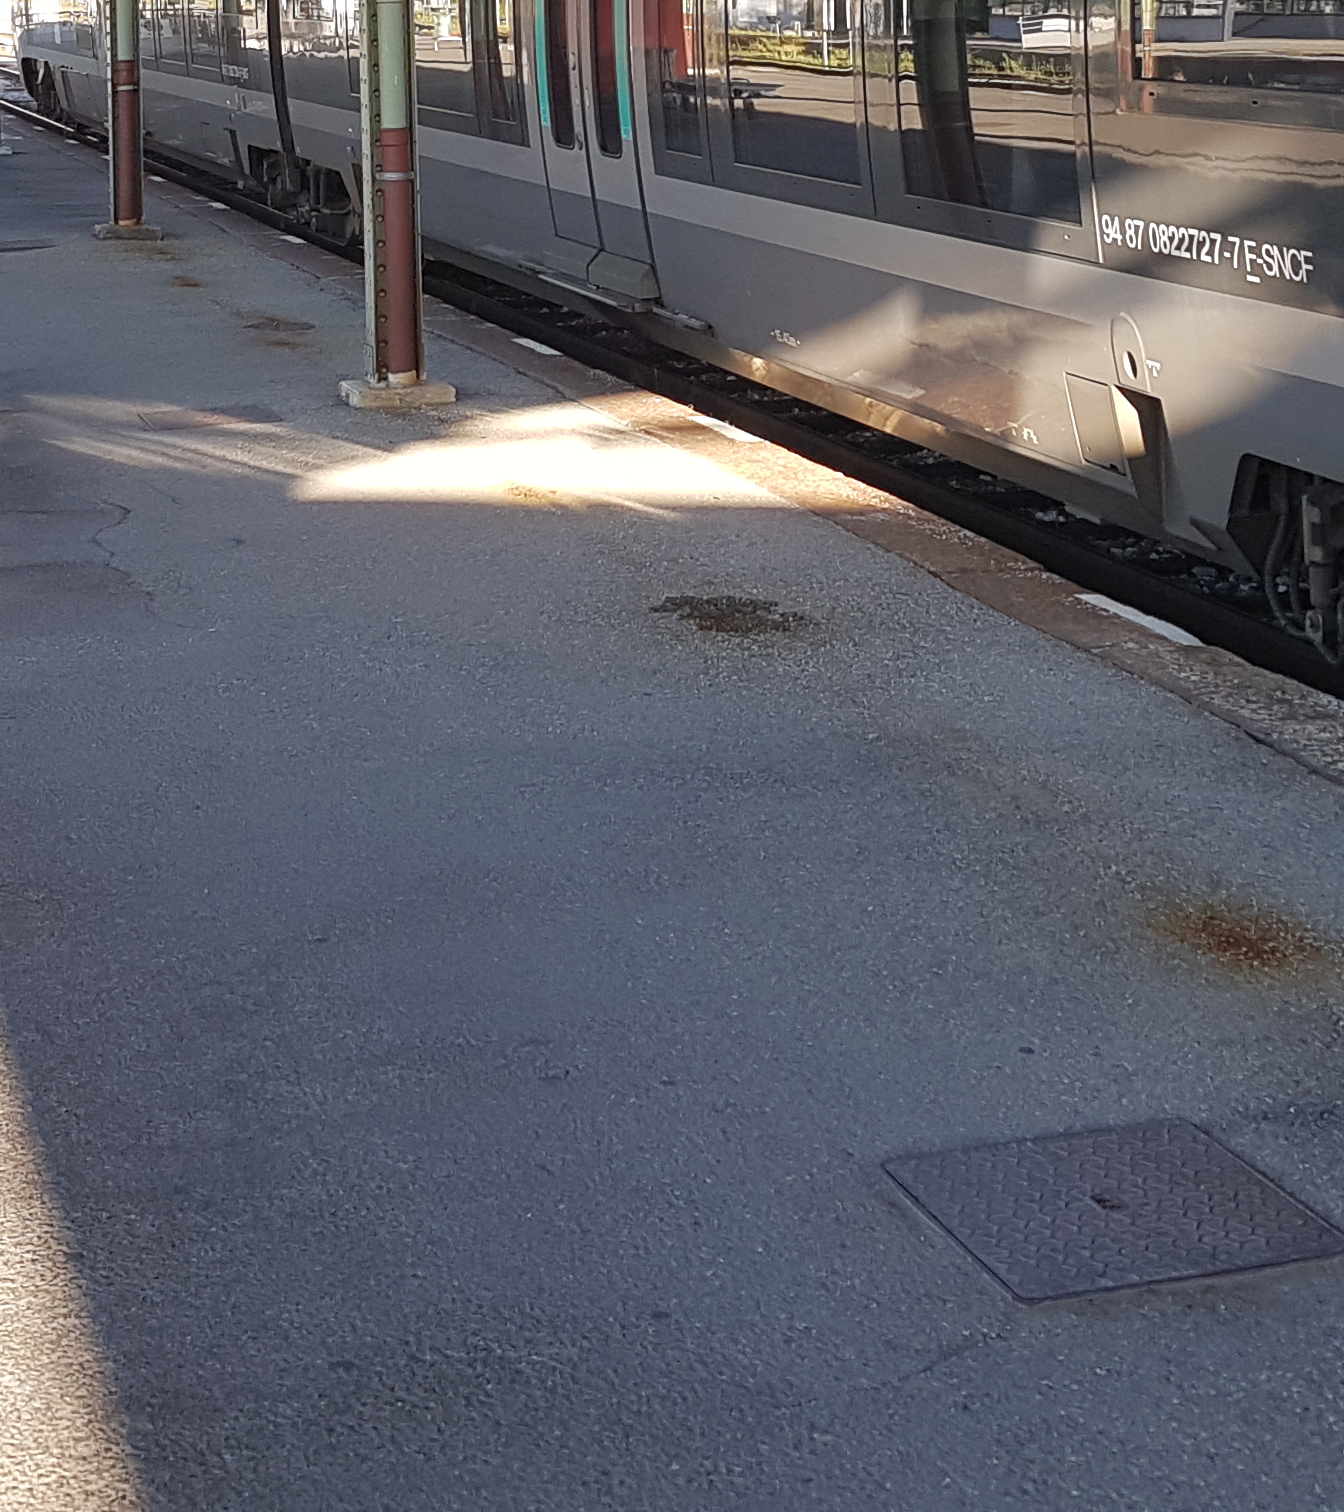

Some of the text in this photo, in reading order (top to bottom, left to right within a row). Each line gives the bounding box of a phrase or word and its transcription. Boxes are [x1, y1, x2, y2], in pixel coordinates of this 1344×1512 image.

[1102, 214, 1314, 284] 94 87 0822727-7 F-SNCF
